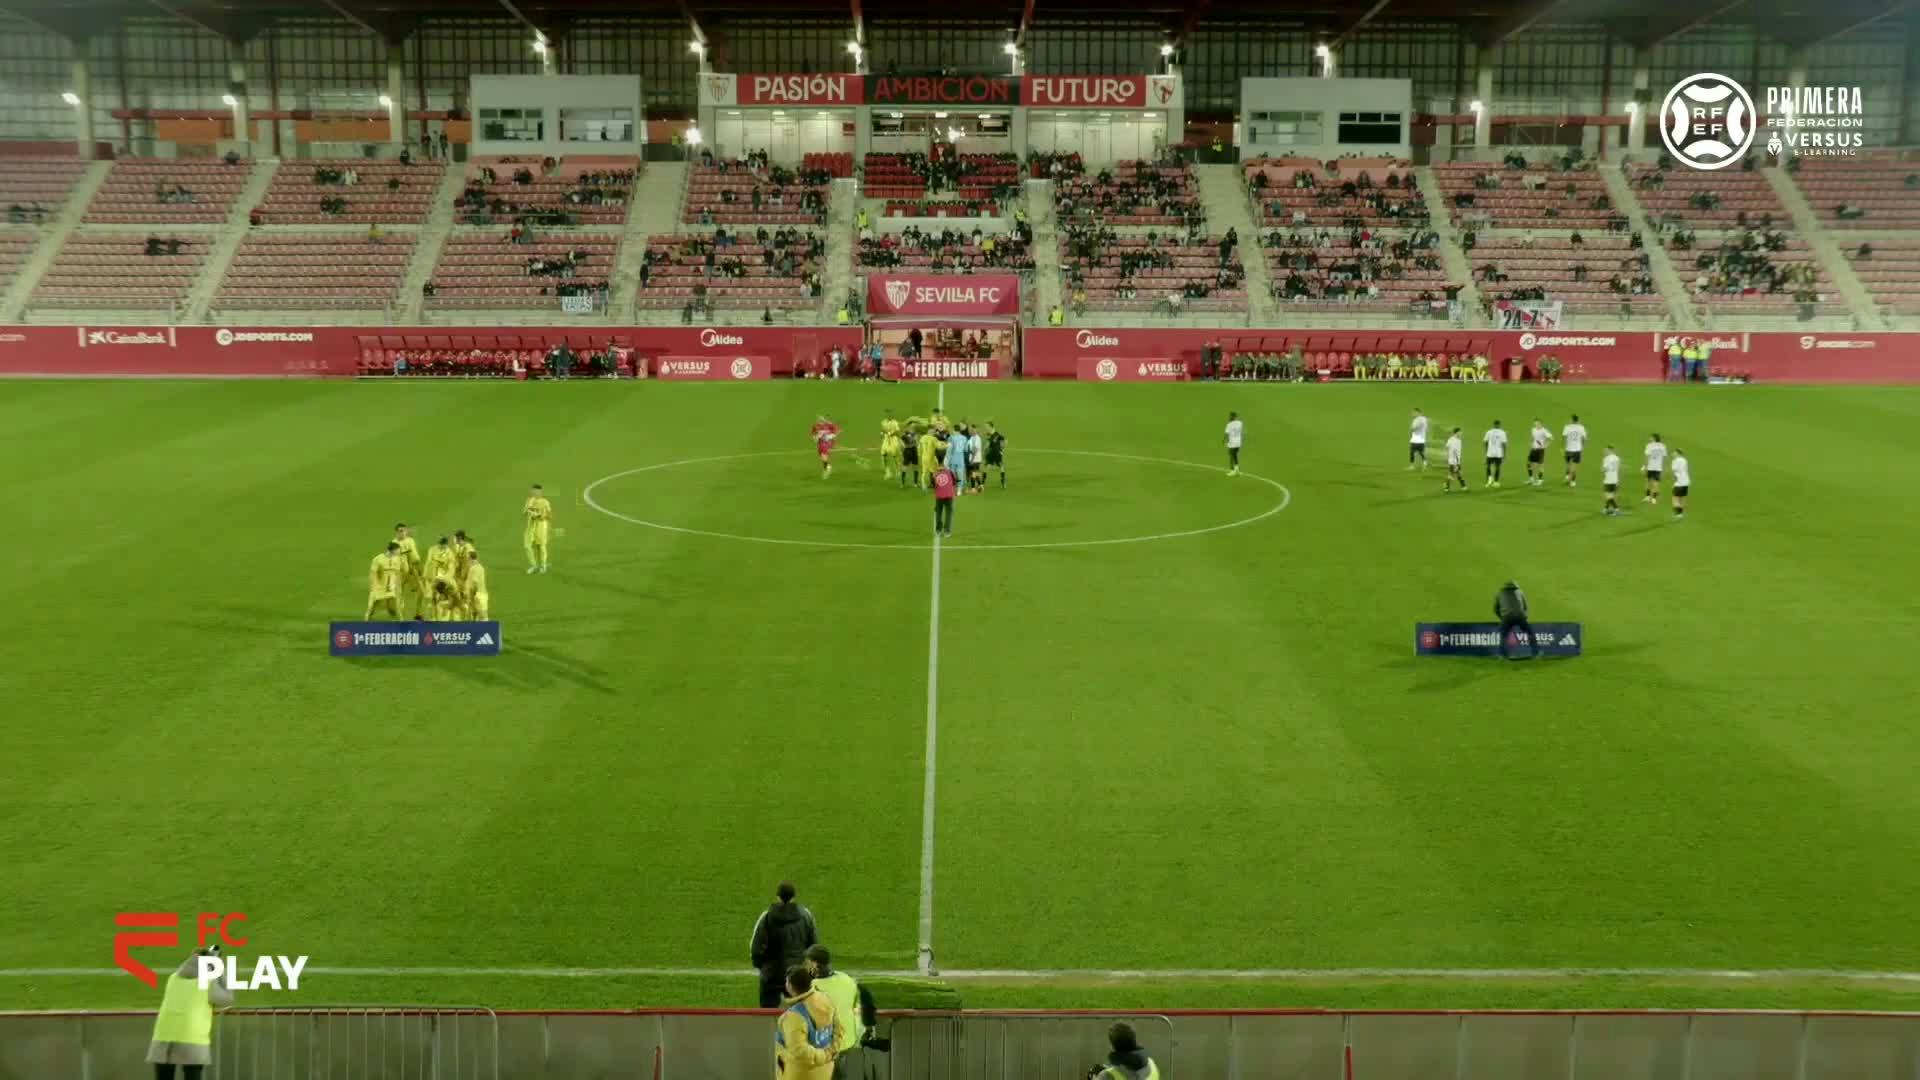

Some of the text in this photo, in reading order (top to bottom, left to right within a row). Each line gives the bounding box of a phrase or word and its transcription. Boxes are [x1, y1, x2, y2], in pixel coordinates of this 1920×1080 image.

[754, 74, 846, 101] PASIÓN
[874, 74, 1008, 102] AMBICIÓN
[1032, 79, 1136, 103] FUTURO
[915, 287, 1000, 303] SEVILLA FC
[703, 331, 744, 346] Midea
[1078, 331, 1119, 347] Midea
[1536, 336, 1617, 346] JDSPORTS.COM
[670, 361, 711, 371] VERSUS
[914, 360, 988, 378] FEDERACIÓN
[1146, 363, 1187, 372] VERSUS
[365, 631, 420, 645] FEDERACIÓN
[432, 632, 472, 641] VERSUS
